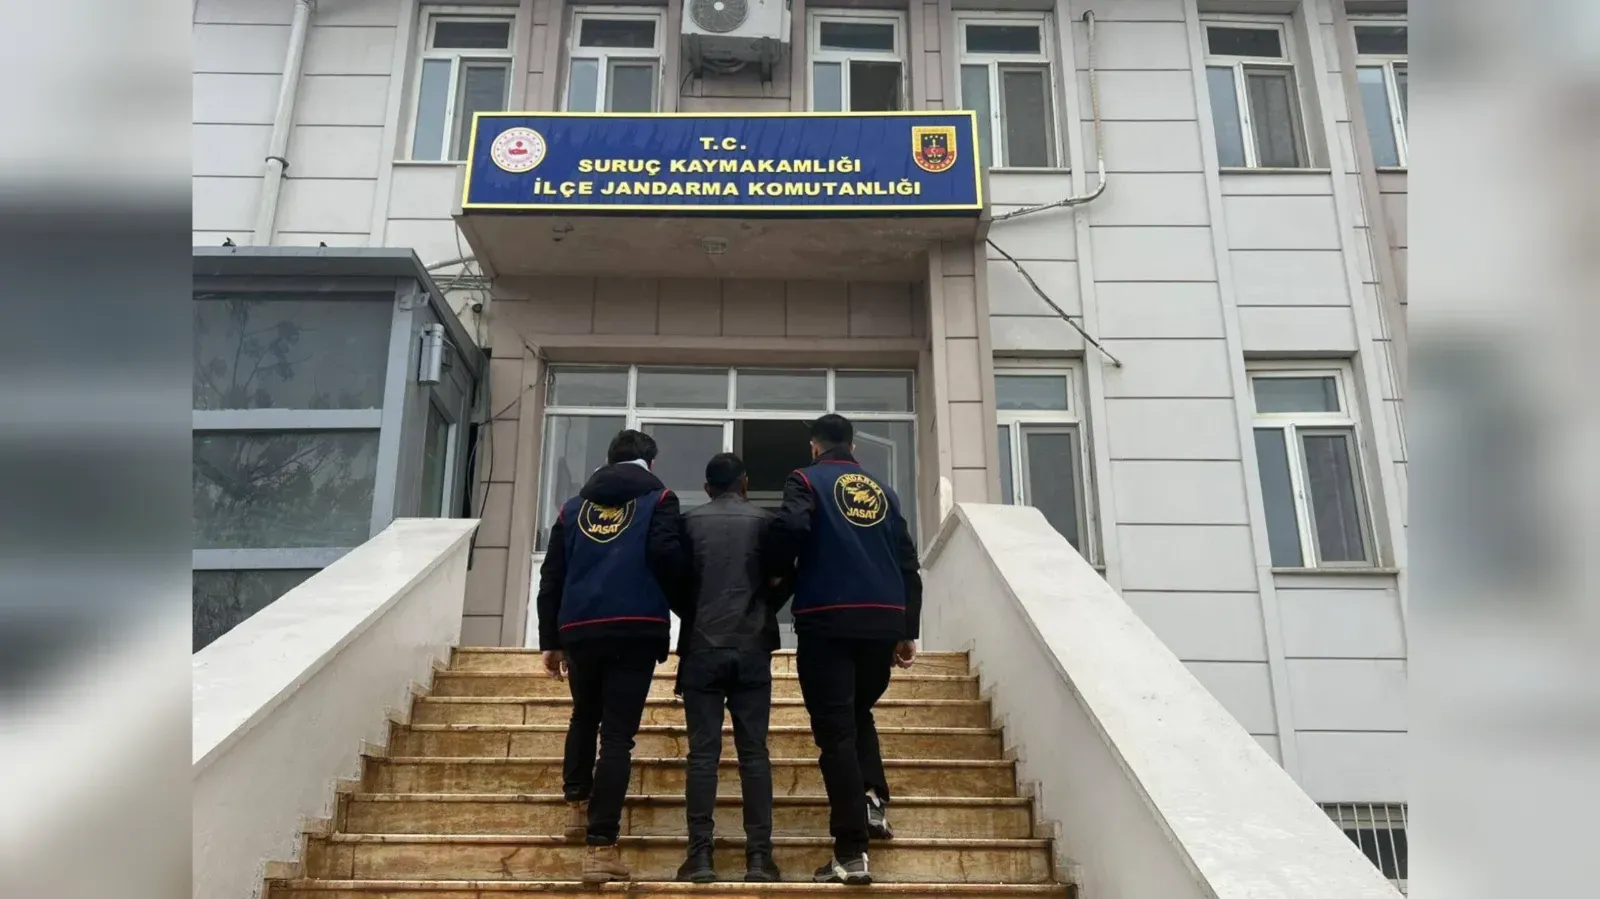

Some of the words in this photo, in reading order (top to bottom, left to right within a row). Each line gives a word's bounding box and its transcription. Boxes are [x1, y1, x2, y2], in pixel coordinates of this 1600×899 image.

[699, 136, 747, 151] T.C.
[577, 158, 661, 176] SURUÇ
[669, 156, 861, 173] KAYMAKAMLIĞI
[533, 177, 593, 198] İLÇE
[600, 181, 739, 196] JANDARMA
[747, 177, 921, 196] KOMUTANLIĞI
[846, 507, 878, 519] JASAT
[588, 523, 620, 534] JASAT
